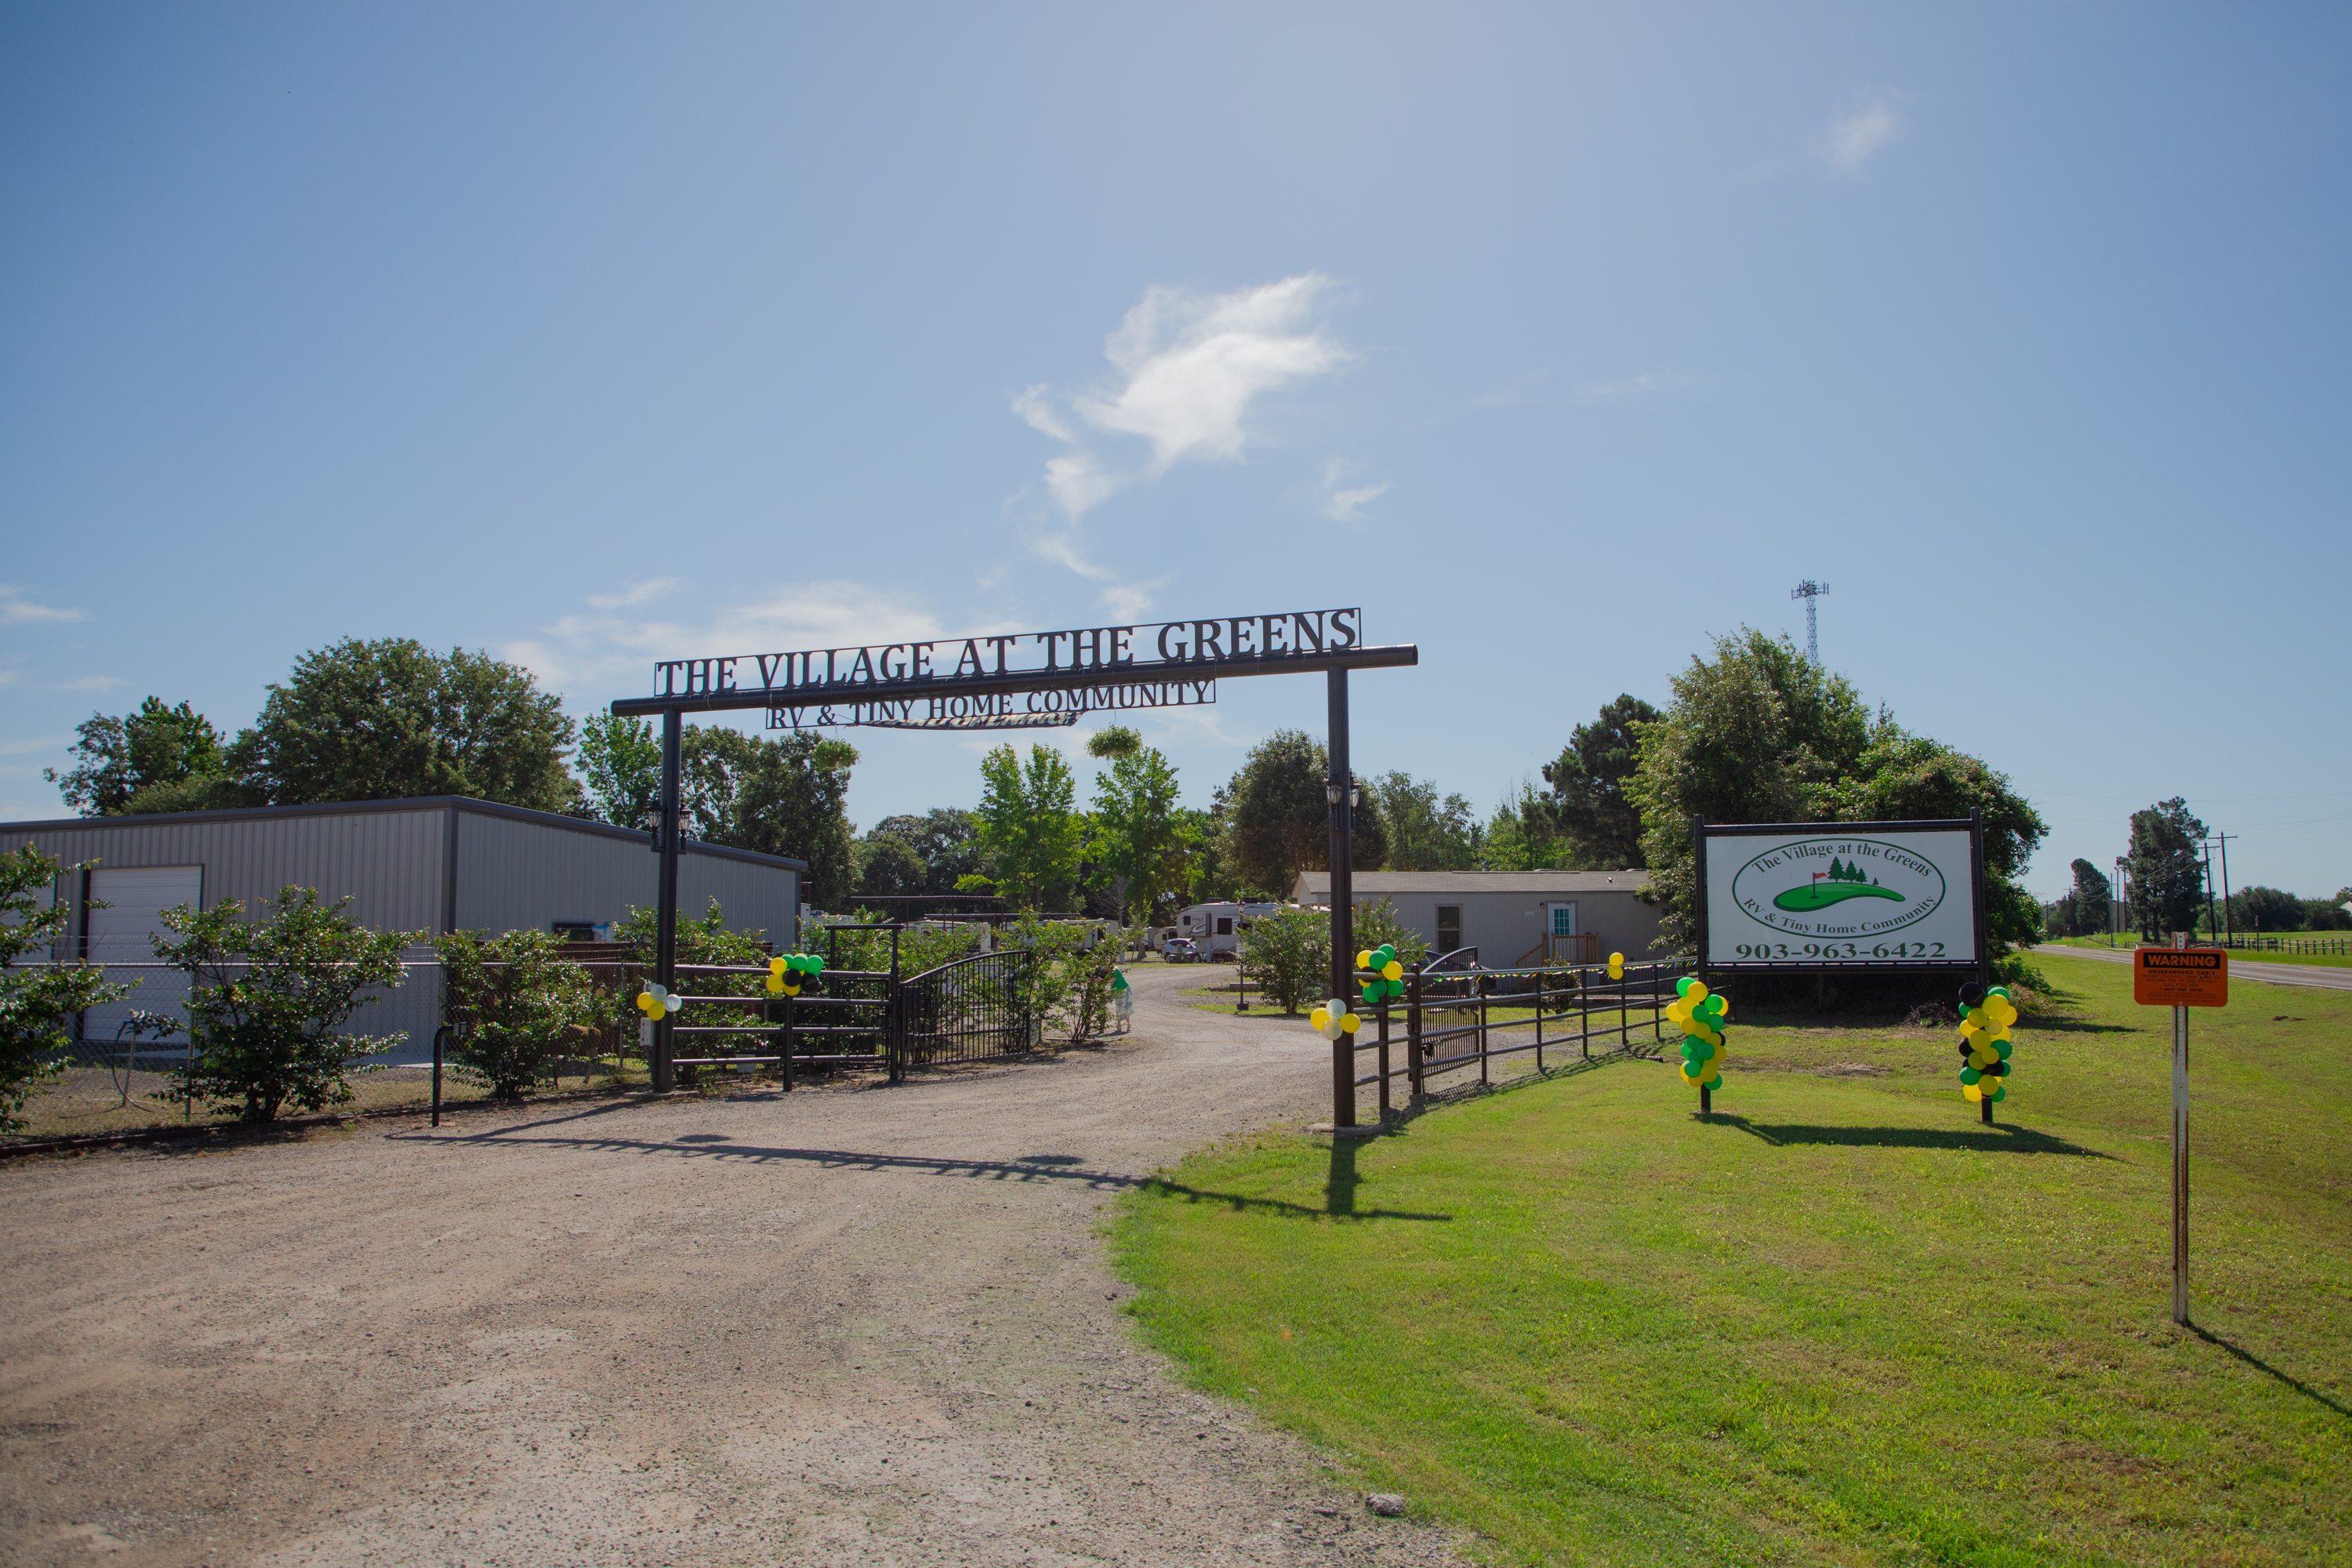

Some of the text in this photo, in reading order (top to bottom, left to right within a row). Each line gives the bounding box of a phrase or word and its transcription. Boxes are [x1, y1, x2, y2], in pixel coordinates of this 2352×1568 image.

[658, 609, 1356, 695] THE VILLAGE AT THE GREENS
[771, 680, 1212, 728] RV & TINY HOME COMMUNITY
[1751, 843, 1932, 877] The Village at the Greens
[1743, 895, 1937, 934] RV & Tiny Home Community
[1736, 942, 1946, 960] 903-963-6422
[2147, 955, 2216, 967] WARNING
